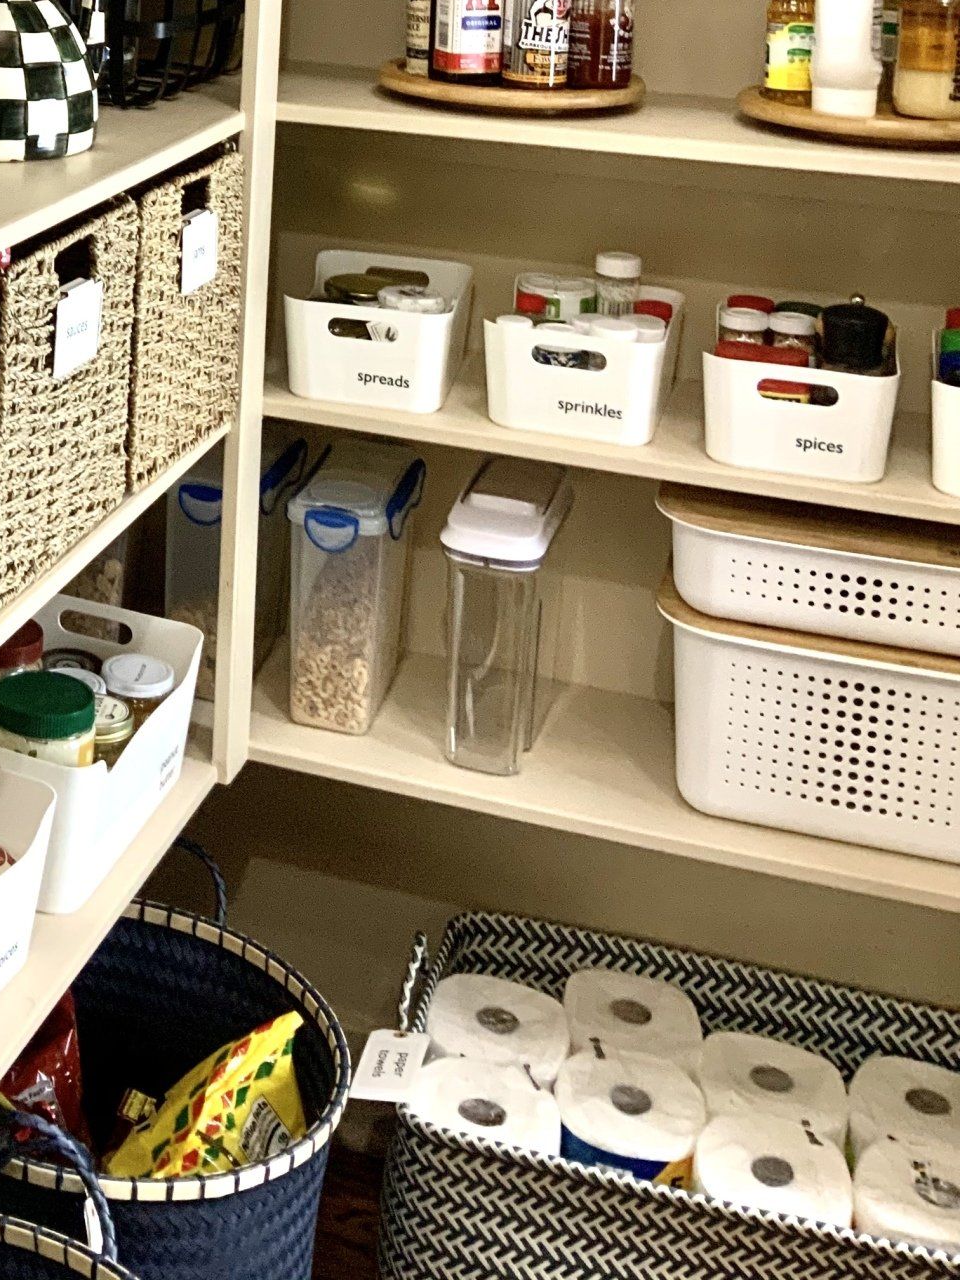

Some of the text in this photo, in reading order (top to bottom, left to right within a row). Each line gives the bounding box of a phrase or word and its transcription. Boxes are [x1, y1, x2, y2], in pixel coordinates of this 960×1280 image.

[524, 21, 552, 42] THE
[357, 371, 410, 389] spreads
[557, 398, 623, 420] sprinkles
[795, 437, 844, 454] spices
[372, 1048, 390, 1078] towels
[394, 1051, 409, 1078] paper
